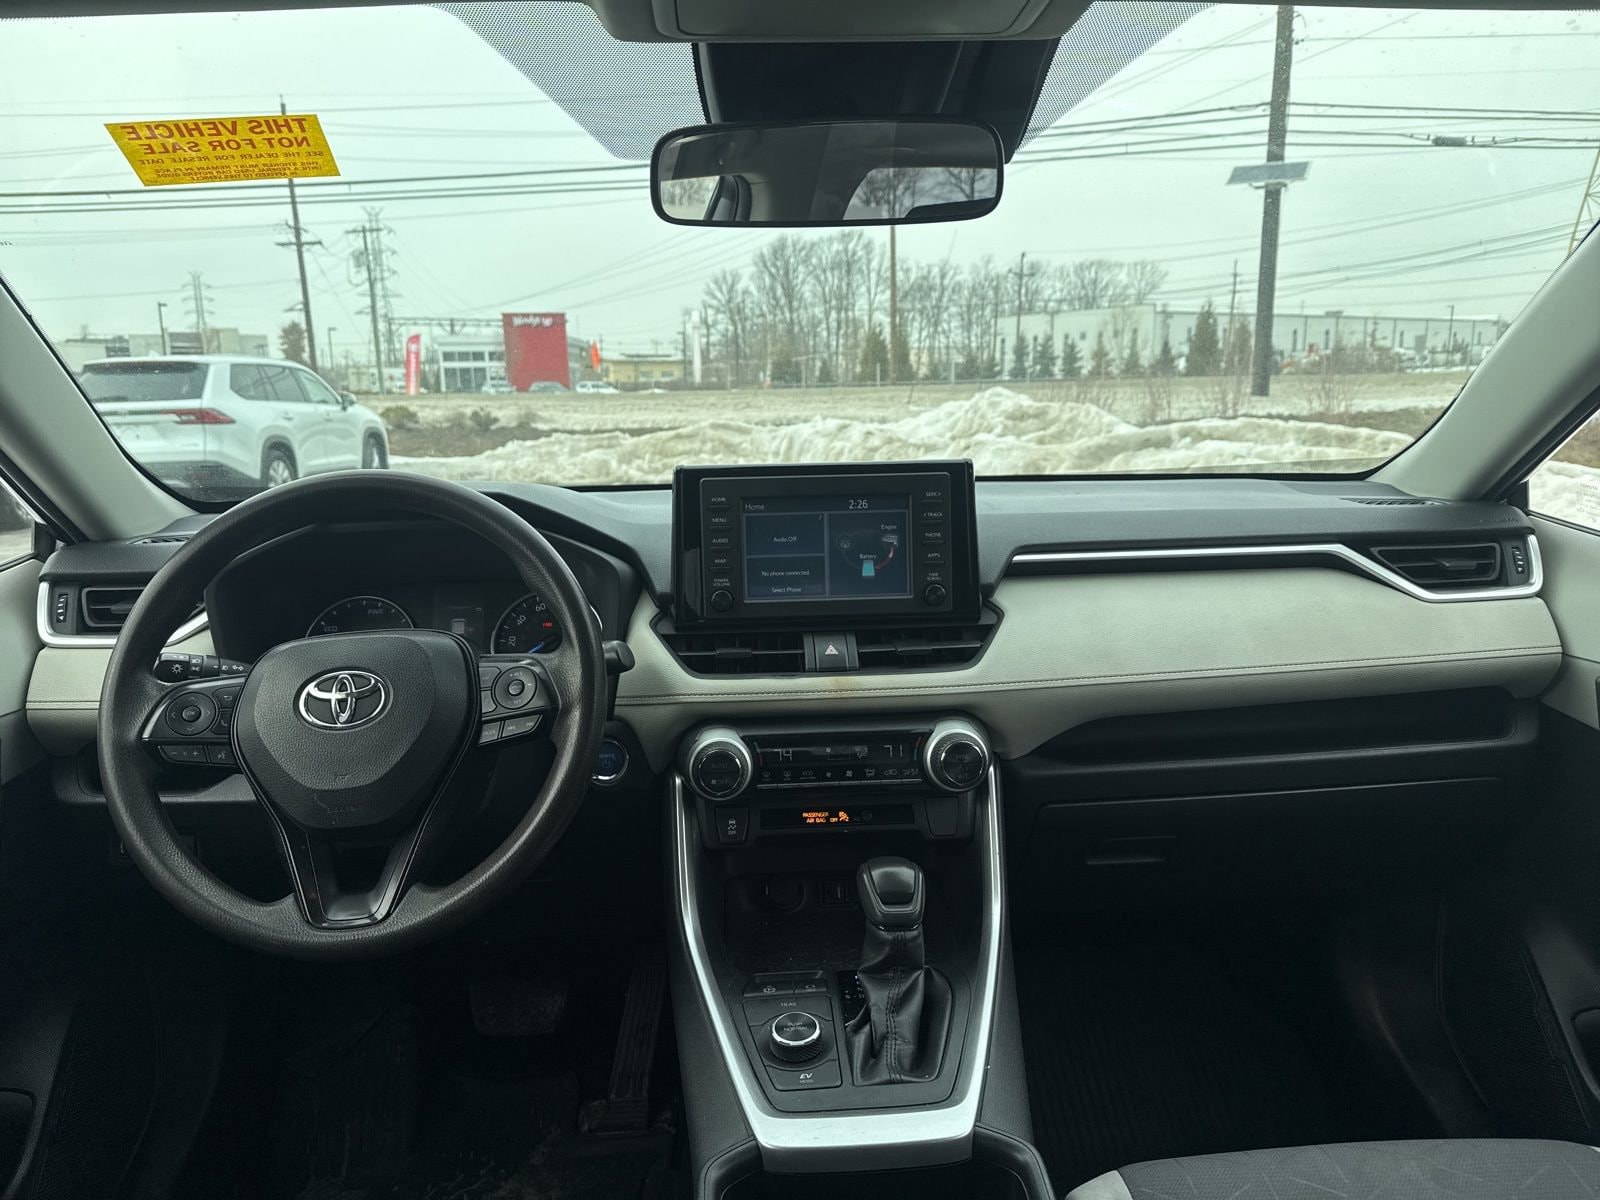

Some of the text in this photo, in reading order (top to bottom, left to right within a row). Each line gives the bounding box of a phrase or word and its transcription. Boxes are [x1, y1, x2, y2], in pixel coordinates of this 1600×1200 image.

[745, 503, 765, 511] Home
[848, 499, 868, 509] 2:26
[535, 602, 546, 612] 60
[517, 614, 527, 626] 40
[508, 635, 516, 646] 20
